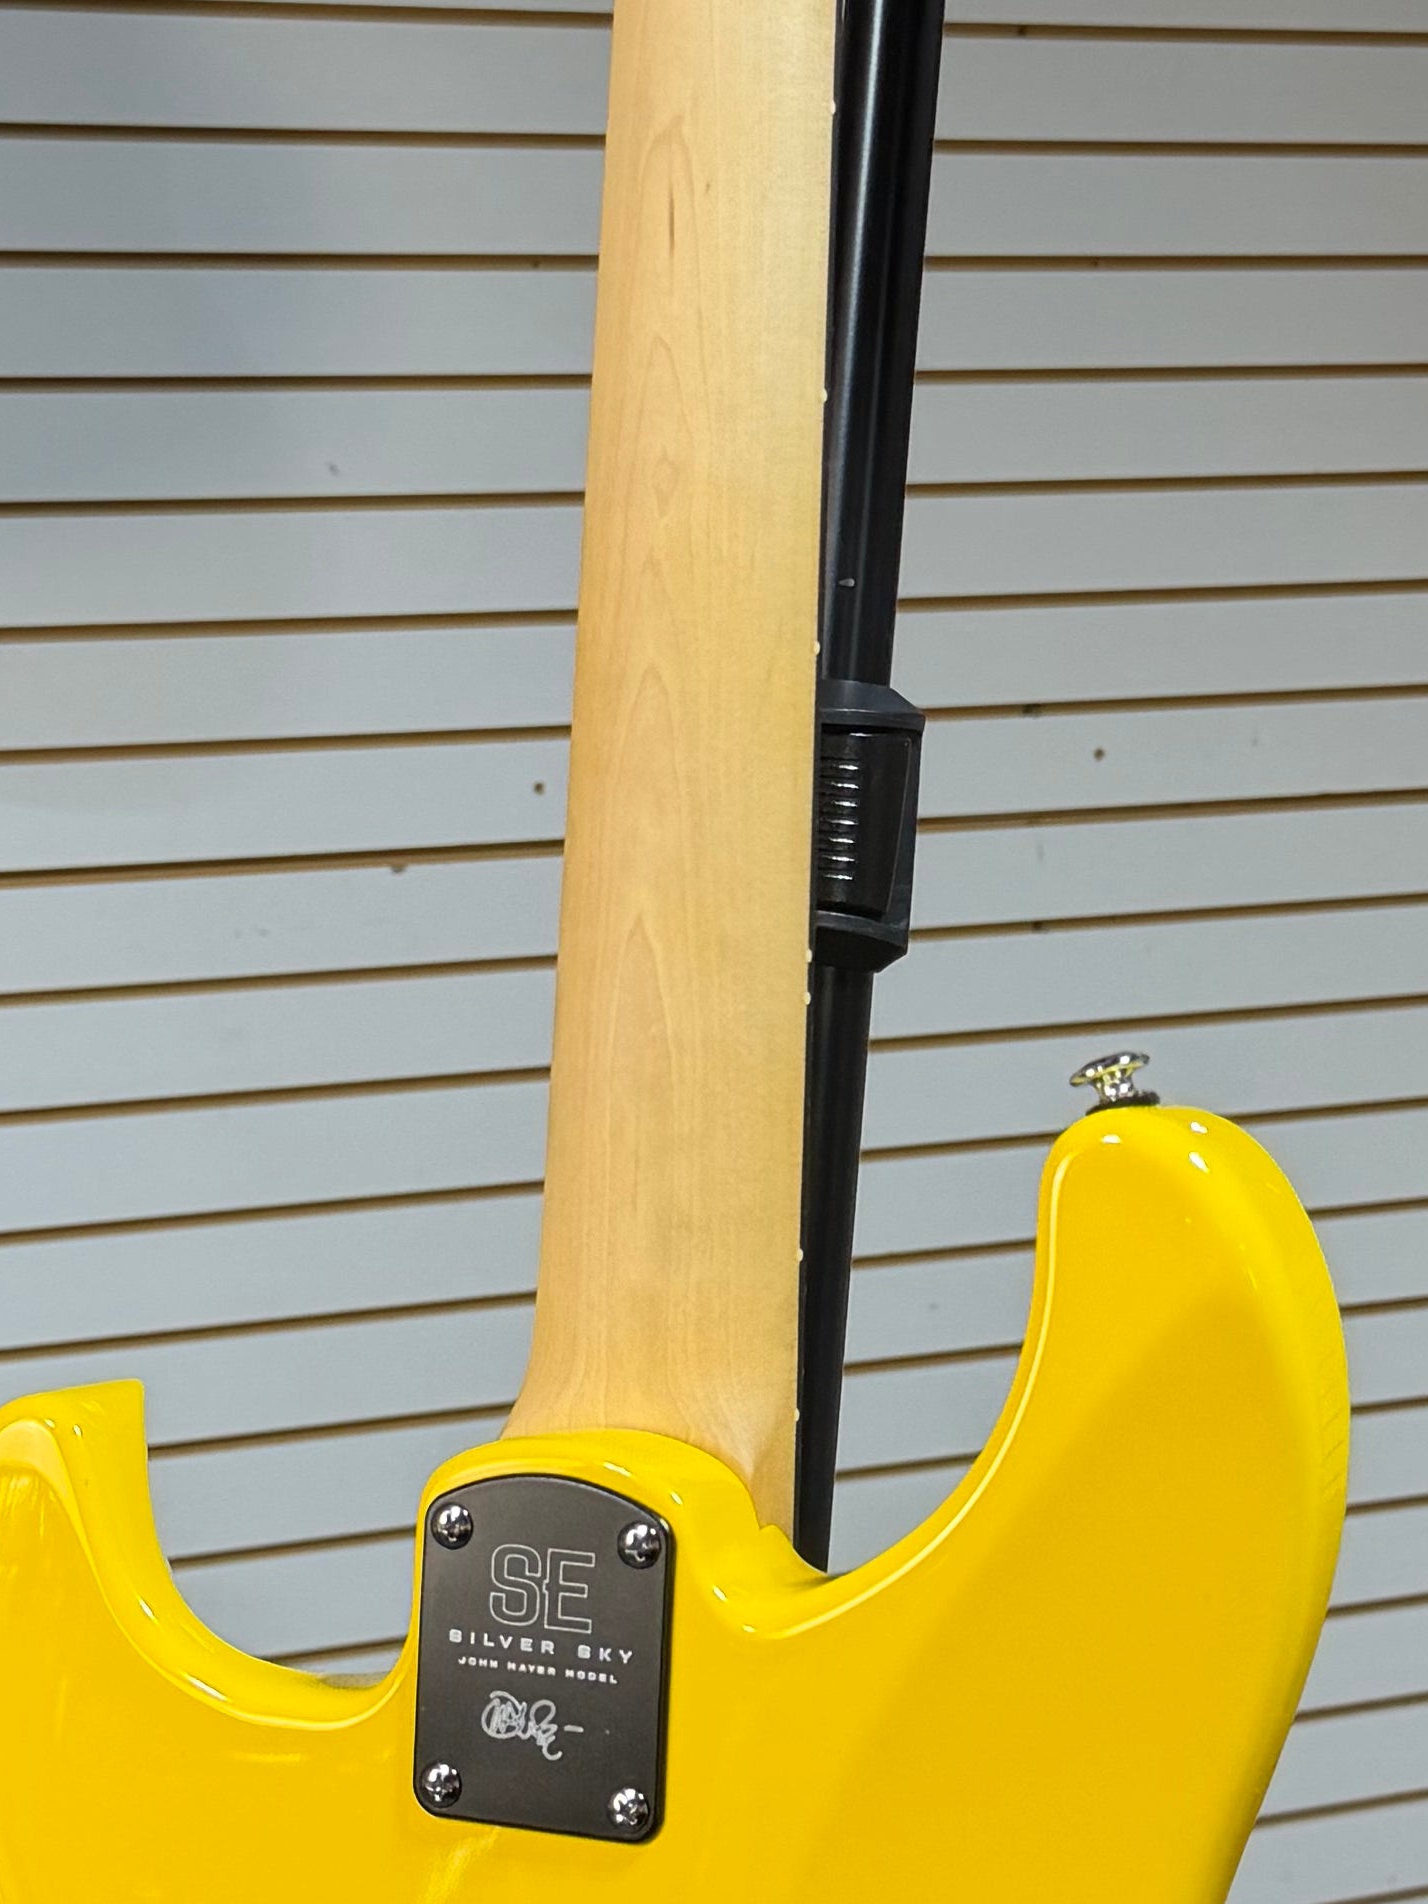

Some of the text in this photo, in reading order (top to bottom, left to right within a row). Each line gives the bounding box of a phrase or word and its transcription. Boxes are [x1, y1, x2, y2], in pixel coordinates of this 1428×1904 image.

[489, 1543, 596, 1634] SE
[448, 1628, 635, 1665] SILVER SKY
[457, 1656, 619, 1685] JOHN MAYER MODEL
